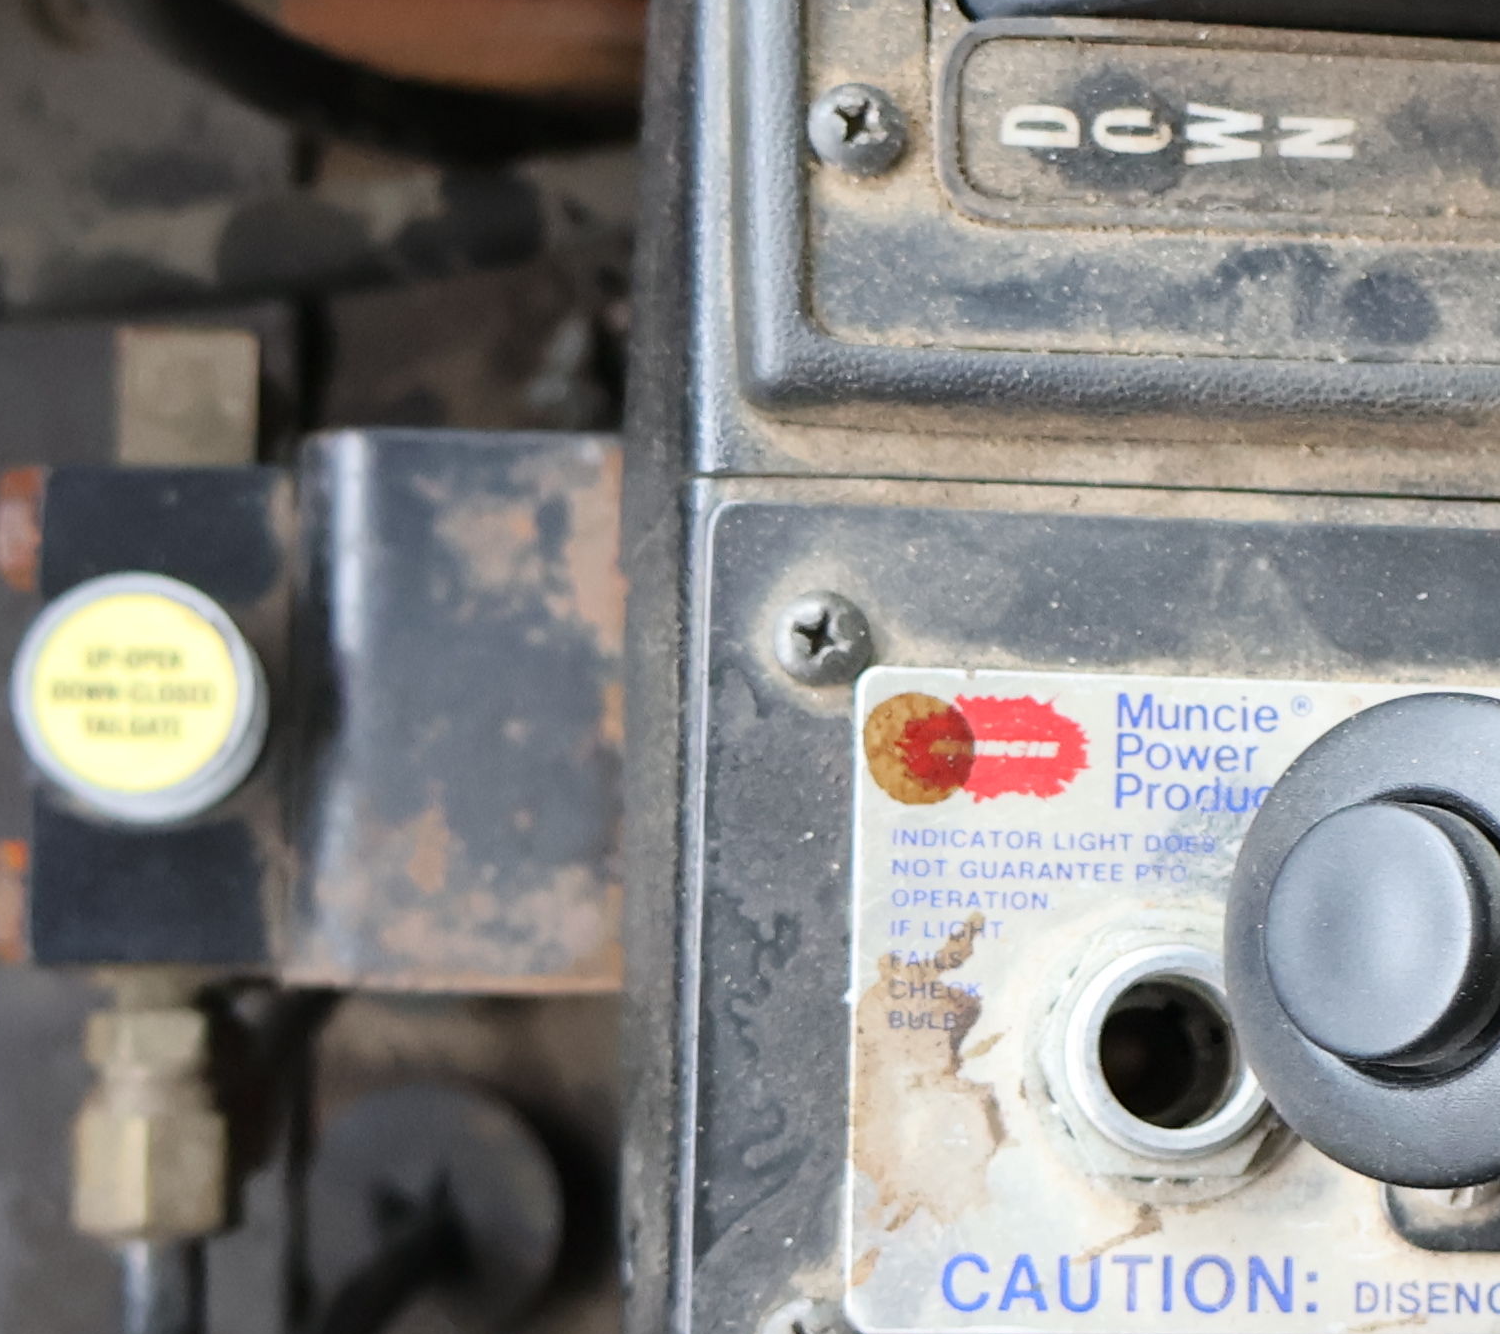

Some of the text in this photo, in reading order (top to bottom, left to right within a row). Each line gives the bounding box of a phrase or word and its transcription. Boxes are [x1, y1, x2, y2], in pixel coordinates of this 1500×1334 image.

[1000, 102, 1356, 166] DOWN
[1116, 692, 1279, 733] Muncie
[1115, 731, 1259, 773] Power
[891, 828, 1042, 851] INDICATOR
[1053, 831, 1133, 852] LIGHT
[891, 858, 1188, 884] NOT GUARANTEE PTO
[889, 919, 1004, 942] IF LIGHT
[941, 1251, 1319, 1314] CAUTION:
